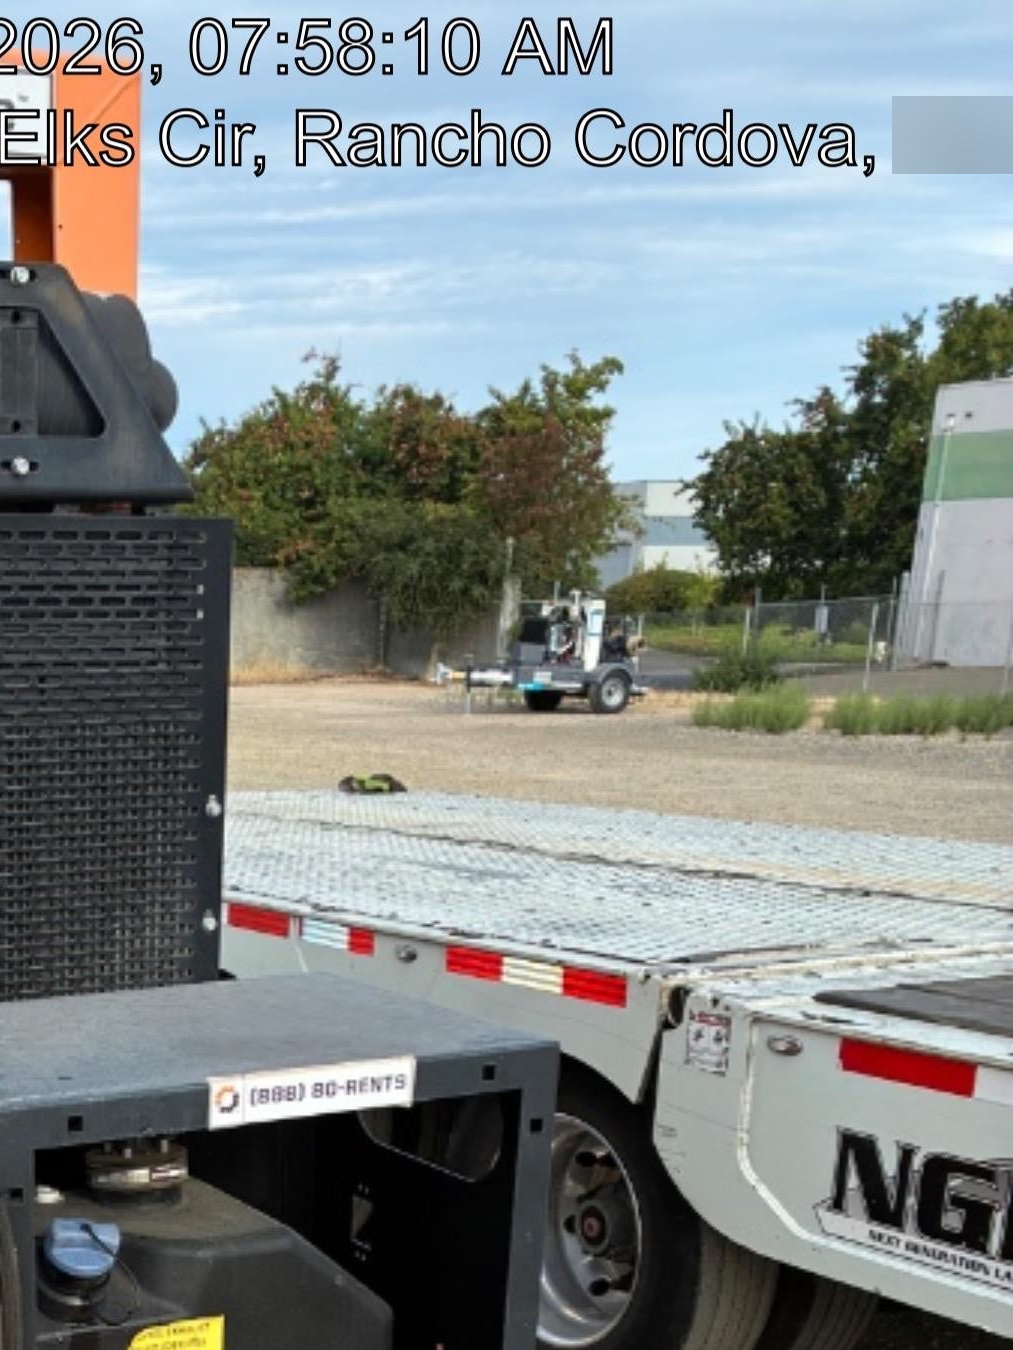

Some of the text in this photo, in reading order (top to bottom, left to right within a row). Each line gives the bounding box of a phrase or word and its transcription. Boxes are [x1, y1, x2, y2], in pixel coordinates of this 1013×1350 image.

[250, 1073, 408, 1107] (888) 80-RENTS
[830, 1125, 1013, 1262] NG
